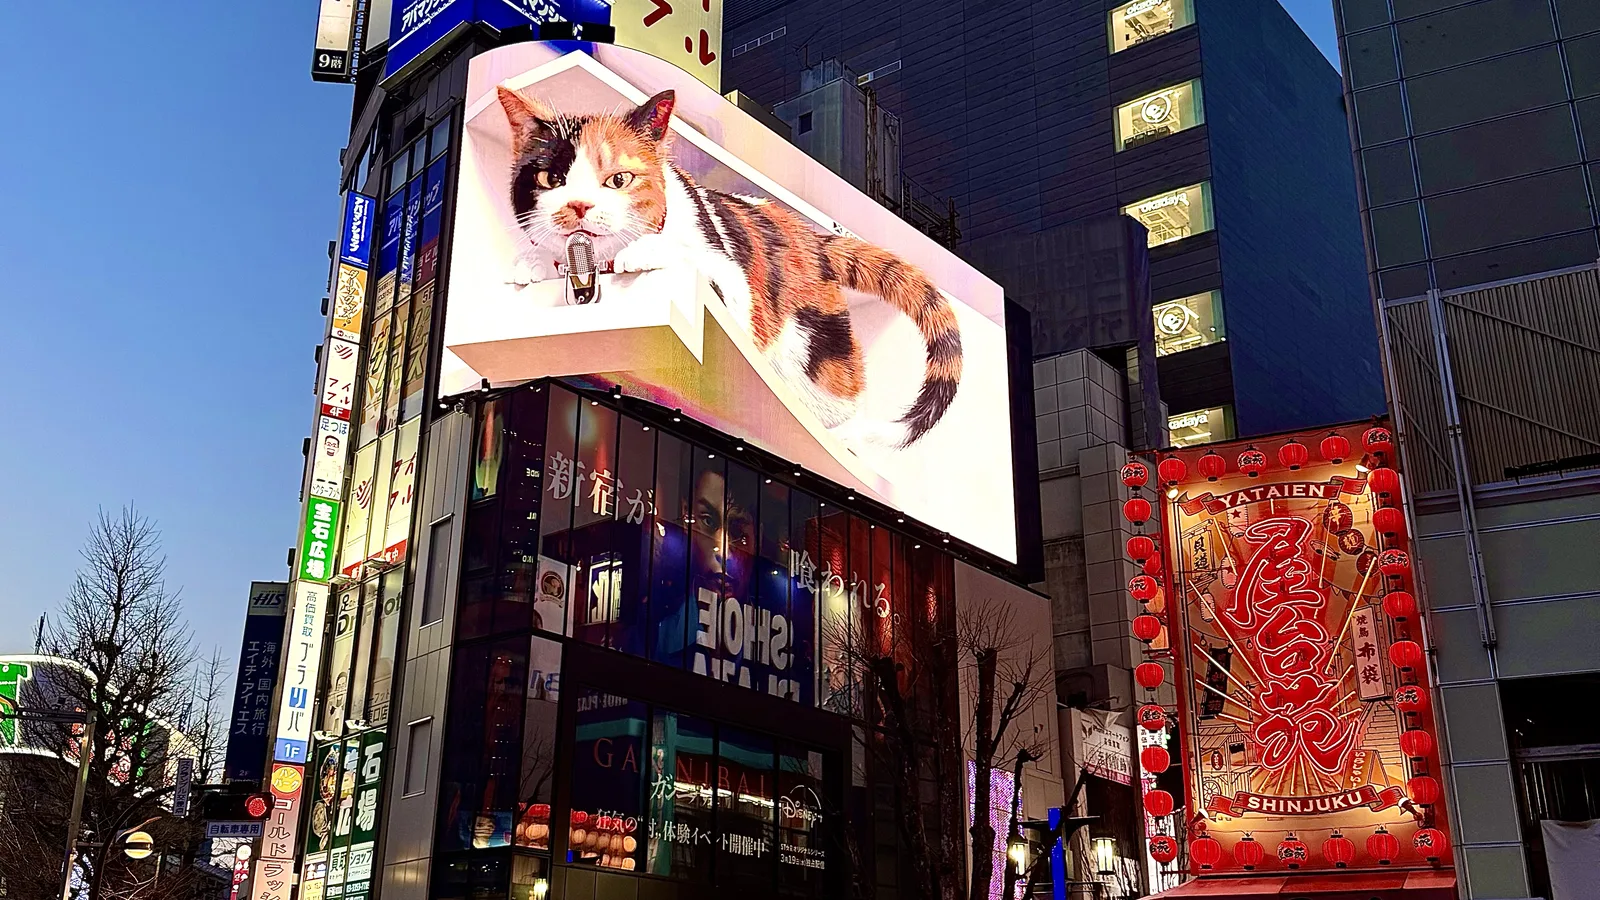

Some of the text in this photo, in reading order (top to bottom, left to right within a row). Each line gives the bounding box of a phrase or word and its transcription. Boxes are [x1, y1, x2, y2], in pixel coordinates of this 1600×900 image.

[329, 407, 343, 417] 4F
[1219, 483, 1326, 511] YATAIEN
[306, 502, 332, 579] 宝石広場
[283, 742, 300, 759] 1F
[1246, 791, 1363, 815] SHINJUKU
[209, 824, 259, 837] 自転車専用
